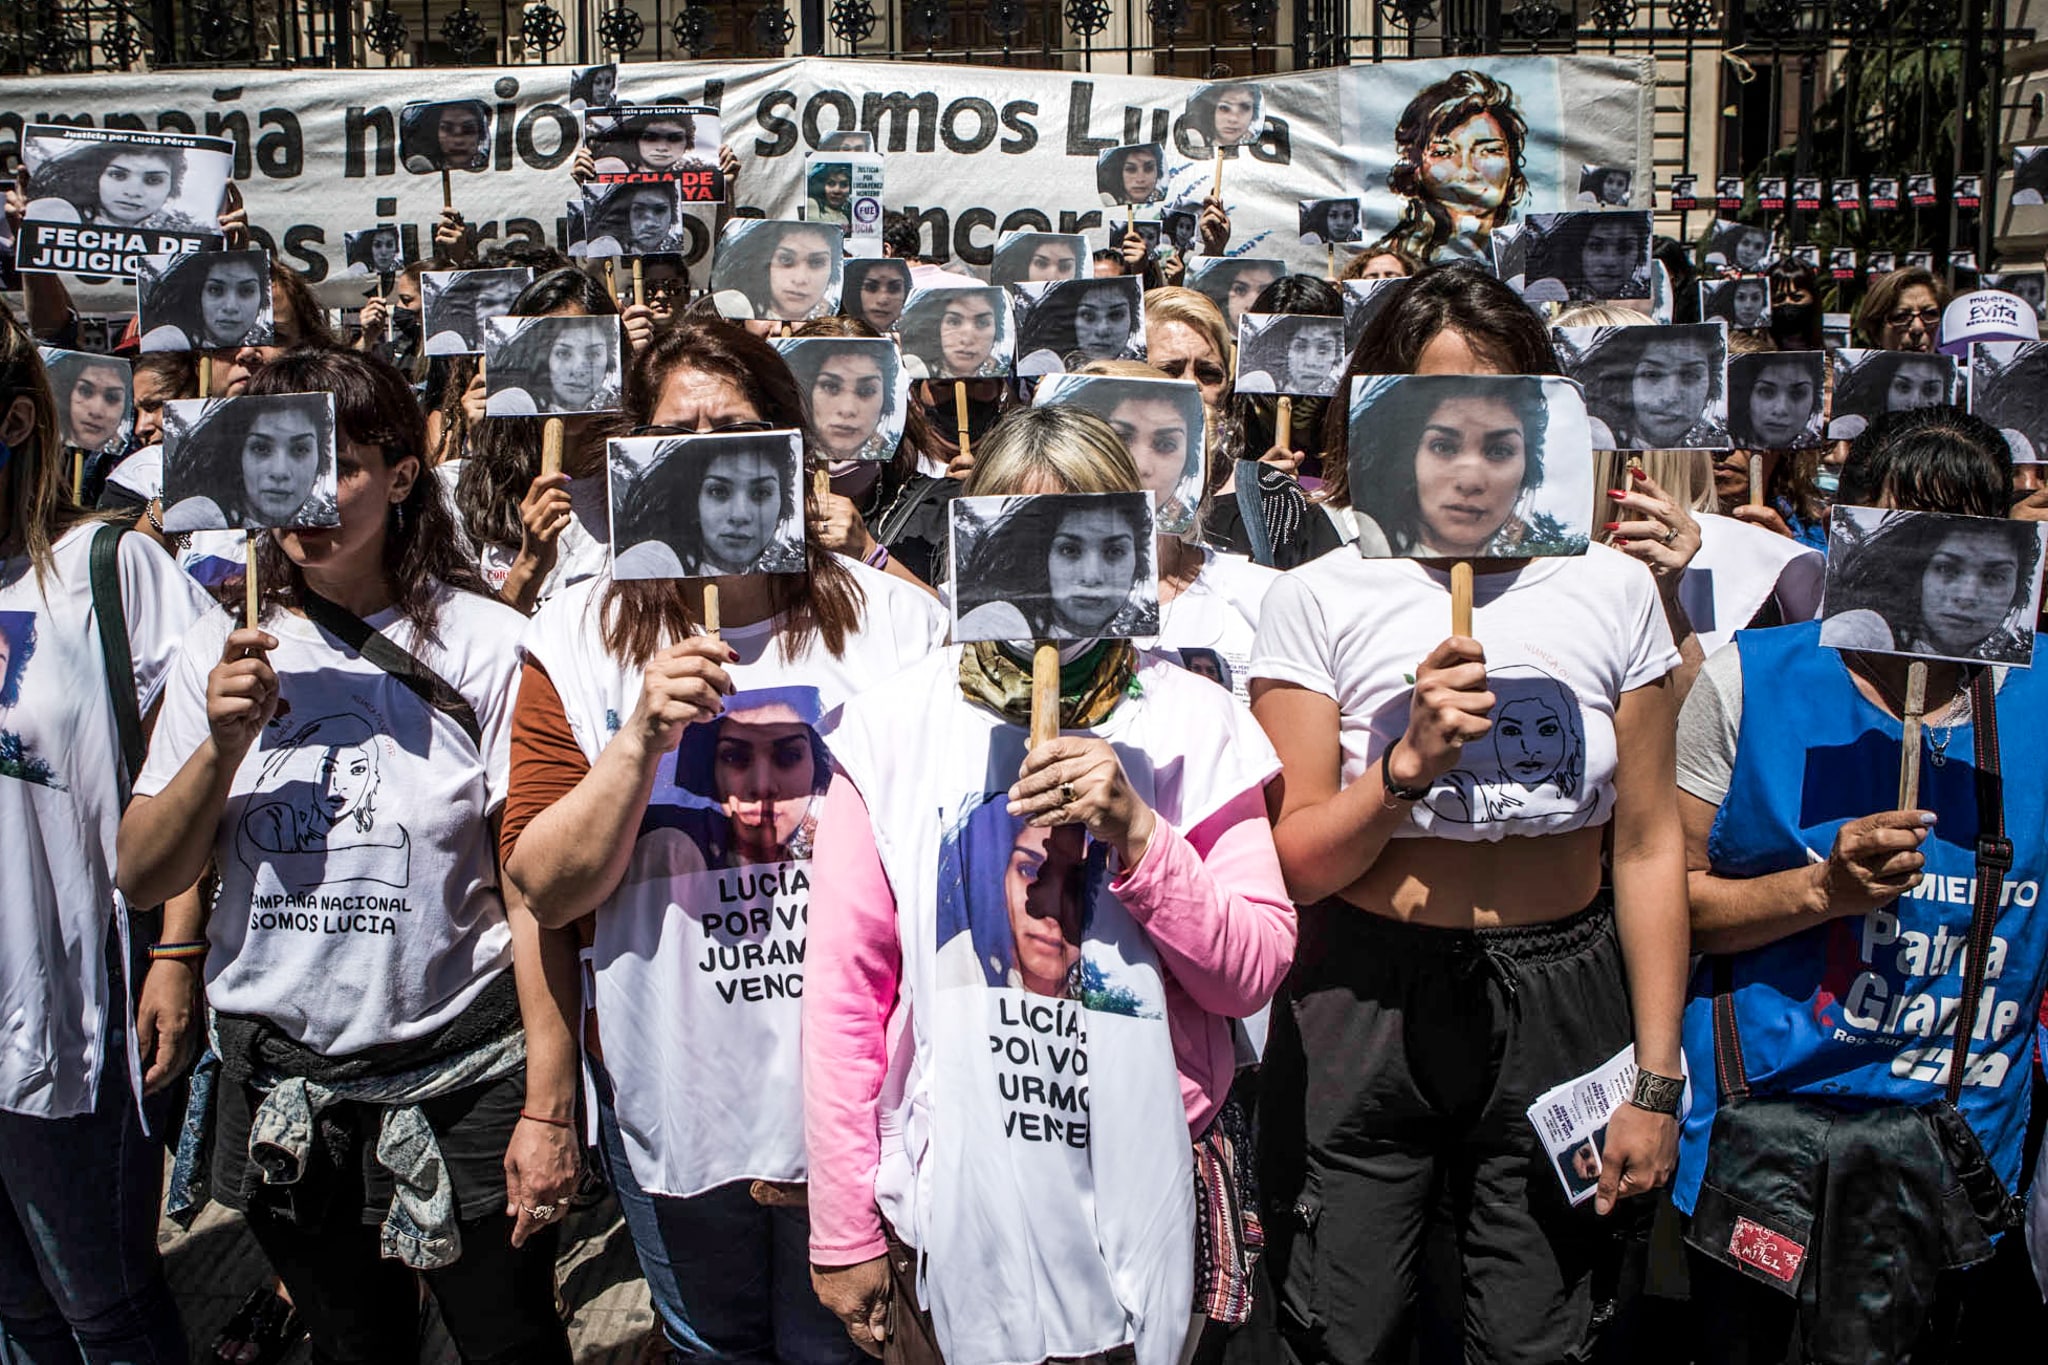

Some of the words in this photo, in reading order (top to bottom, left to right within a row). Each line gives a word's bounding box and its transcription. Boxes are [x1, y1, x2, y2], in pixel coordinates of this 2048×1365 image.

[755, 88, 1038, 157] somos
[1066, 80, 1291, 165] Luca
[63, 130, 107, 140] Justicia
[108, 134, 129, 142] por
[163, 136, 197, 147] Pérez
[682, 172, 714, 186] DE
[682, 186, 714, 201] YA
[859, 206, 875, 215] FUE
[37, 226, 148, 253] FECHA
[158, 236, 202, 255] DE
[1970, 304, 2017, 321] Evita
[250, 891, 318, 910] AMPAÑA
[321, 896, 412, 912] NACIONAL
[250, 912, 318, 933] SOMOS
[323, 914, 396, 936] LUCIA
[702, 908, 771, 938] POR
